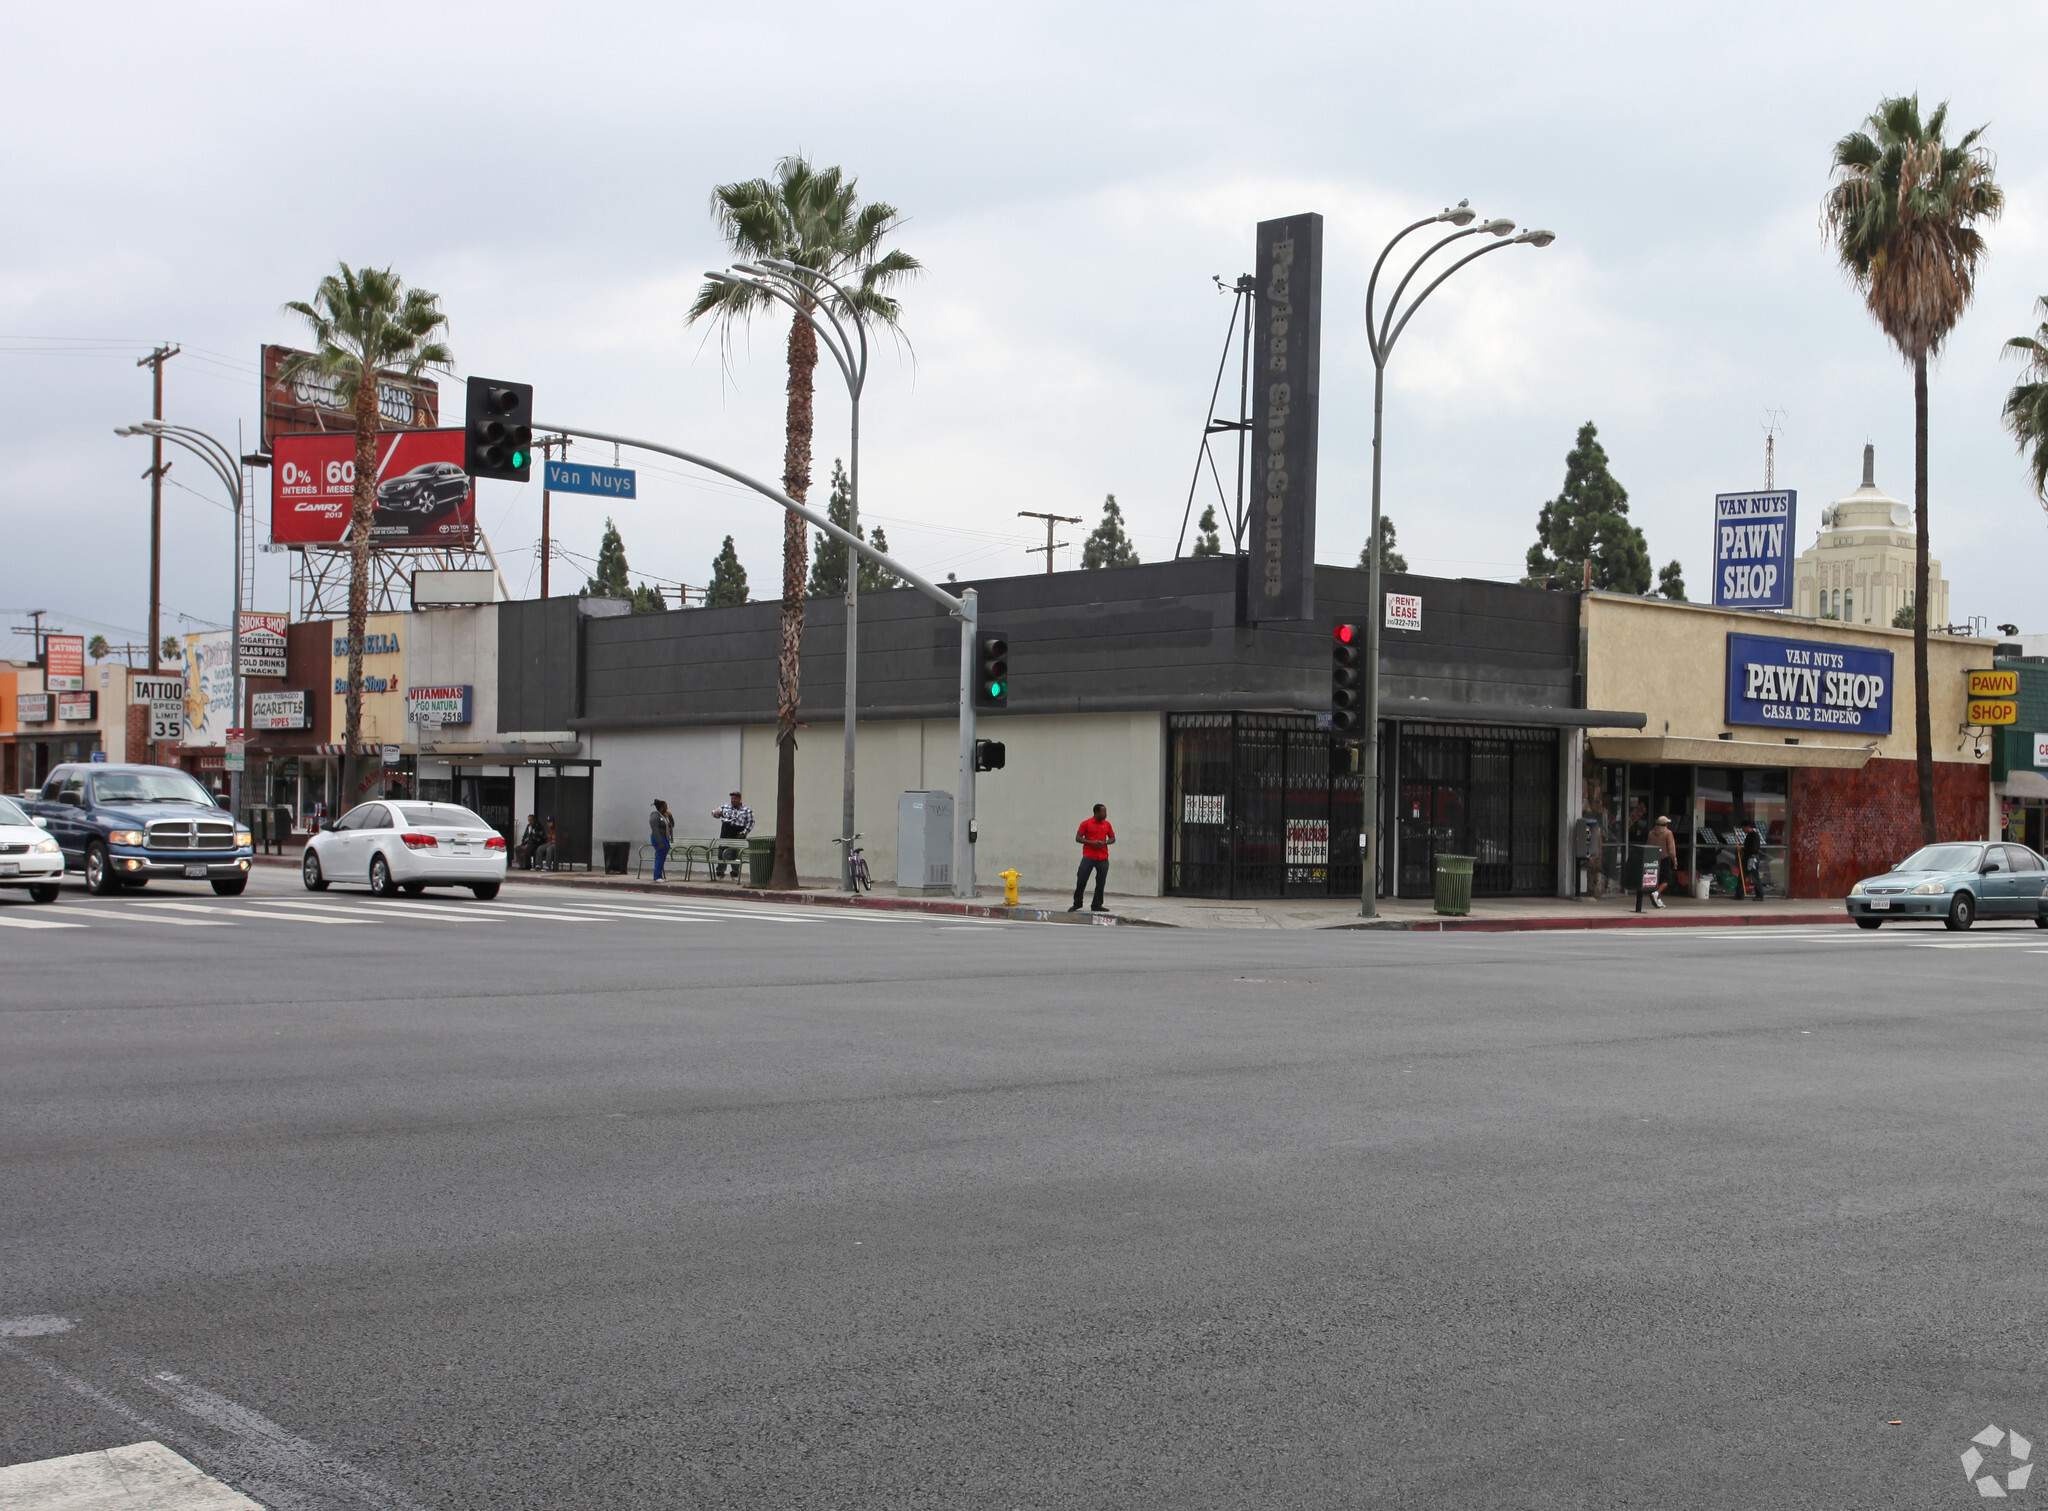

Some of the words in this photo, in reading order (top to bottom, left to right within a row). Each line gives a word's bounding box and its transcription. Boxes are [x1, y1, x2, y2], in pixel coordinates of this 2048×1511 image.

[282, 462, 311, 485] 0%
[326, 461, 356, 484] 60
[551, 466, 580, 485] Van
[591, 471, 631, 492] Nuys
[282, 485, 318, 495] INTERÉS
[326, 485, 355, 494] MESES
[1719, 499, 1748, 515] VAN
[1750, 496, 1788, 513] NUYS
[1720, 524, 1784, 560] PAWN
[1724, 564, 1778, 599] SHOP
[1395, 596, 1416, 606] RENT
[1391, 605, 1417, 619] LEASE
[239, 615, 265, 633] SMOKE
[266, 617, 286, 635] SHOP
[48, 644, 83, 653] LATINO
[240, 637, 285, 645] CIGARETTES
[240, 646, 263, 655] GLASS
[264, 648, 285, 657] PIPES
[1786, 649, 1810, 666] VAN
[1814, 652, 1844, 669] NUYS
[259, 659, 285, 668] DRINKS
[135, 681, 182, 699] TATTOO
[365, 675, 387, 695] Shop
[1744, 663, 1822, 704] PAWN
[1823, 670, 1885, 709] SHOP
[1971, 677, 2013, 691] PAWN
[409, 687, 463, 700] VITAMINAS
[153, 702, 181, 710] SPEED
[253, 700, 303, 716] CIGARETTES
[431, 700, 458, 711] NATURA
[270, 717, 290, 727] PIPES
[1762, 704, 1793, 720] CASA
[1795, 706, 1811, 722] DE
[1813, 706, 1861, 725] EMPEÑO
[154, 721, 181, 737] 35
[1288, 828, 1304, 842] FOR
[1305, 828, 1327, 842] LEASE
